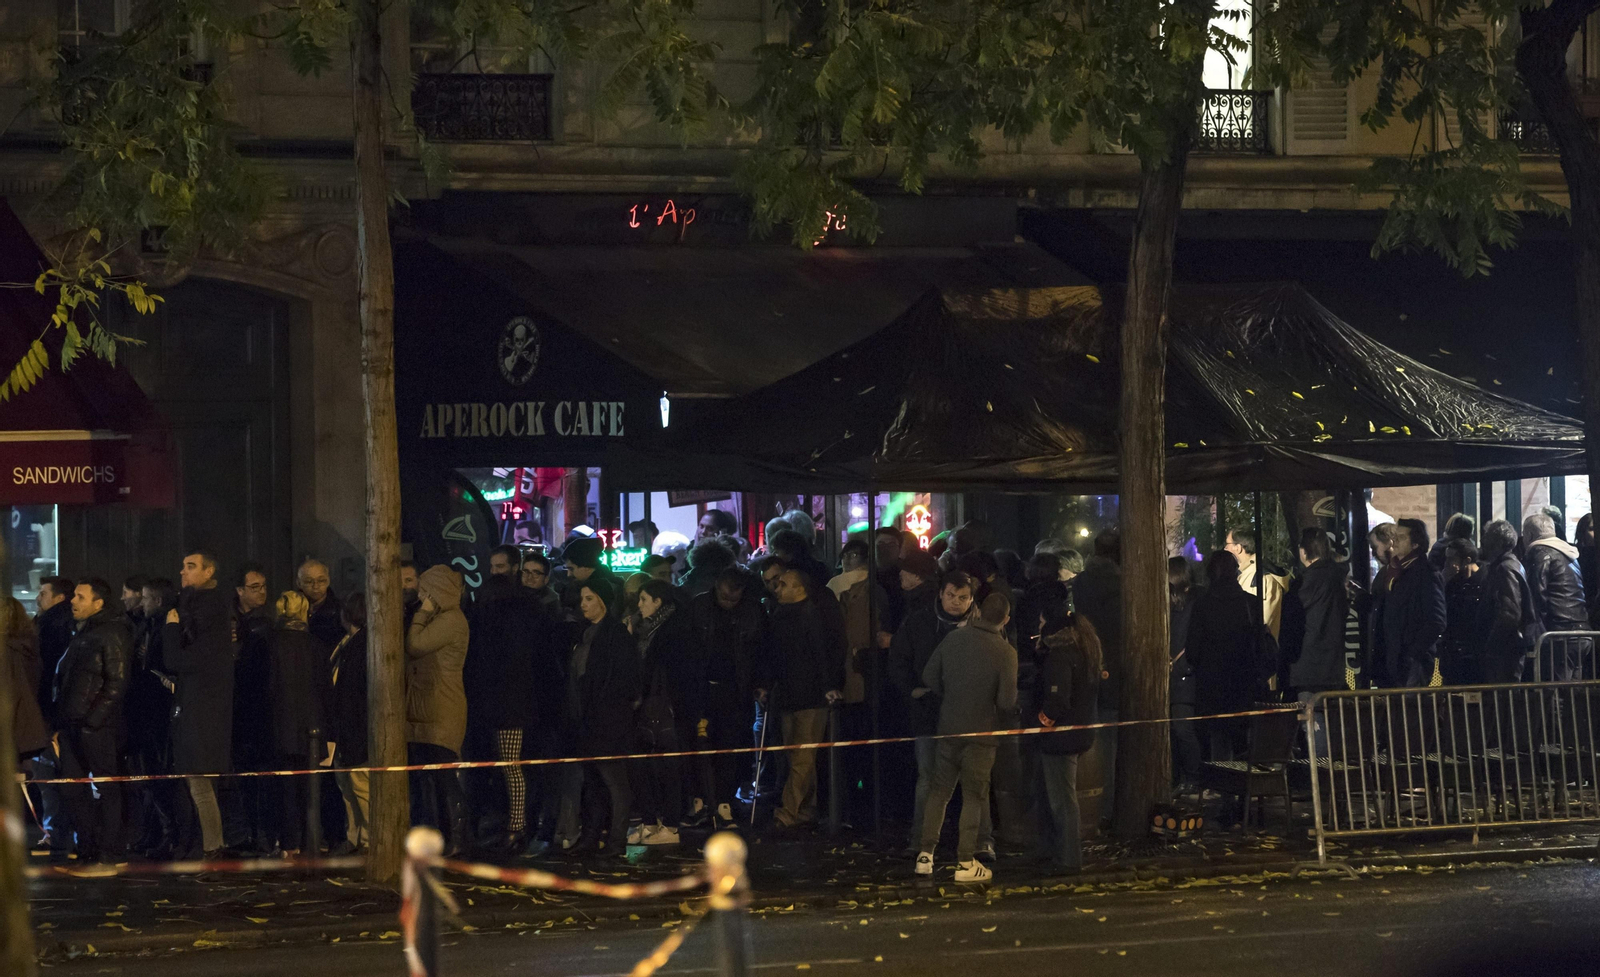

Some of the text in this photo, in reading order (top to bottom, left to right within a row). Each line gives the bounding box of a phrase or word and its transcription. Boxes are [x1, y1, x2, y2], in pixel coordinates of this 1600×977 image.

[419, 401, 625, 439] APEROCK CAFE
[12, 465, 116, 485] SANDWICHS
